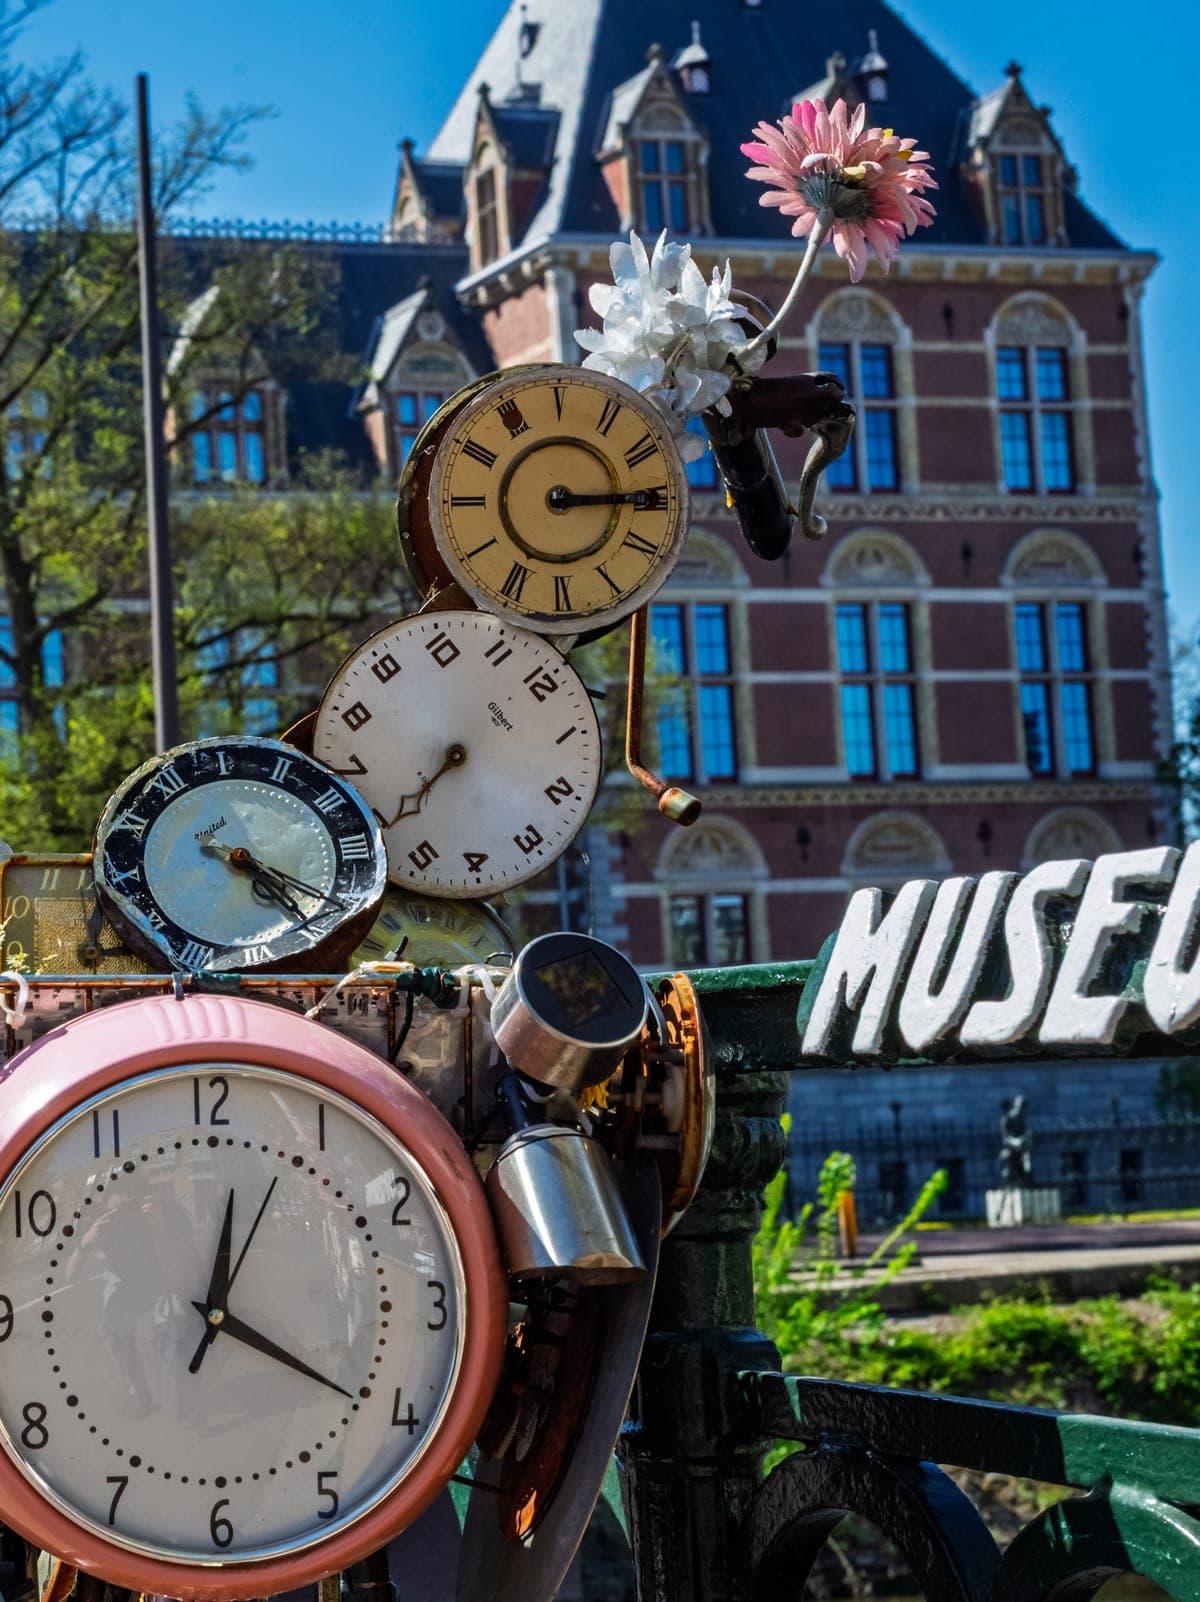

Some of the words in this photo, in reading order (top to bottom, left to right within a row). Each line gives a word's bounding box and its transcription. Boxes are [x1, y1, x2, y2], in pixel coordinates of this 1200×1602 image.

[550, 386, 568, 422] V
[595, 397, 625, 437] VI
[460, 436, 498, 471] III
[623, 429, 660, 472] VII
[450, 493, 486, 509] II
[465, 535, 499, 563] I
[622, 531, 660, 565] IX
[498, 560, 537, 604] XII
[552, 575, 574, 612] XI
[593, 561, 626, 600] X
[425, 631, 461, 668] 10
[484, 640, 513, 667] 11
[371, 653, 402, 684] 9
[522, 665, 559, 703] 12
[341, 701, 372, 731] 8
[487, 701, 514, 732] Gilbert
[555, 726, 577, 745] 1
[216, 751, 230, 776] I
[270, 756, 293, 783] II
[335, 754, 368, 777] 7
[152, 766, 188, 800] XII
[313, 786, 347, 814] III
[544, 776, 574, 806] 2
[339, 833, 370, 861] IIII
[408, 840, 440, 871] 5
[513, 824, 544, 855] 3
[39, 868, 61, 890] 11
[462, 852, 489, 873] 4
[3, 895, 31, 918] 10
[244, 944, 275, 965] VII
[194, 1076, 230, 1126] 12
[93, 1110, 120, 1158] 11
[319, 1103, 326, 1151] 1
[14, 1189, 57, 1238] 10
[391, 1176, 412, 1226] 2
[427, 1281, 448, 1331] 3
[20, 1402, 49, 1449] 8
[391, 1387, 420, 1435] 4
[106, 1476, 129, 1526] 7
[316, 1471, 340, 1519] 5
[209, 1499, 234, 1548] 6
